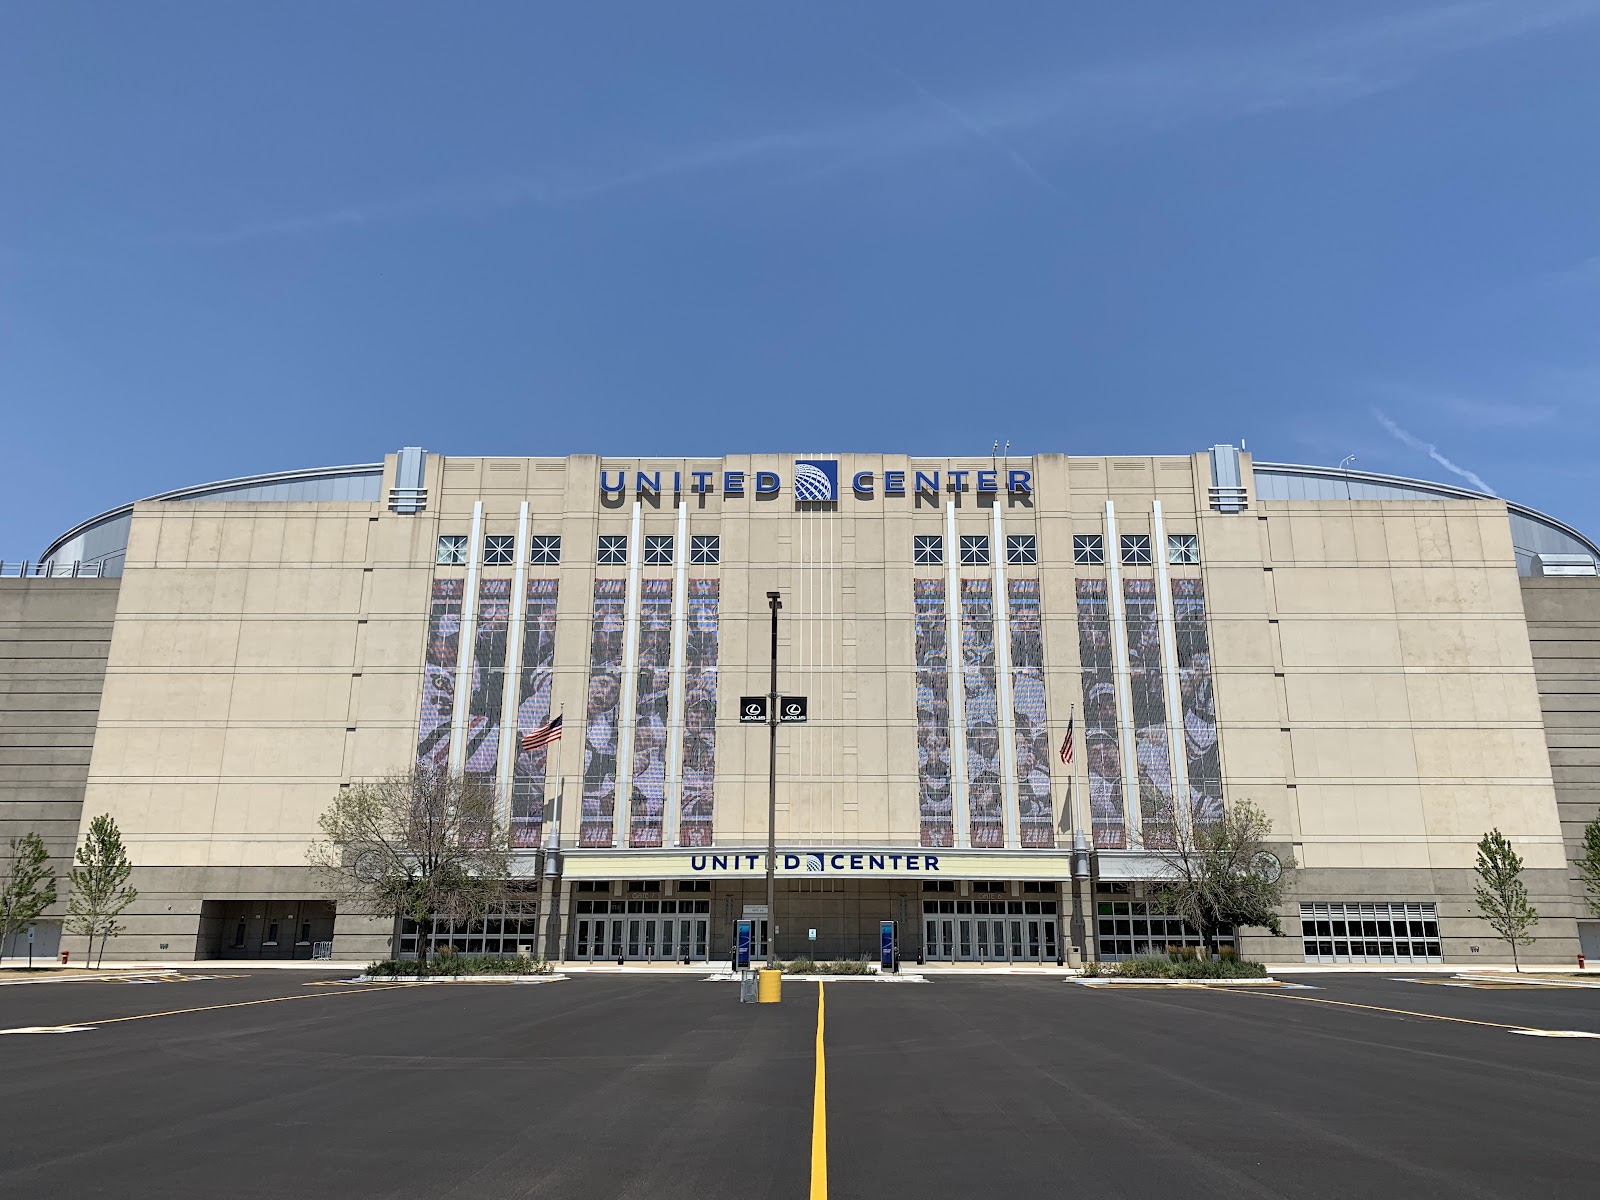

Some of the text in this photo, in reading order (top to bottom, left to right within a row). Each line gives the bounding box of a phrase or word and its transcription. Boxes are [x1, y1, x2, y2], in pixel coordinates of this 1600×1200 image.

[600, 471, 1032, 492] UNITED CENTER
[691, 854, 939, 871] UNITD CENTER
